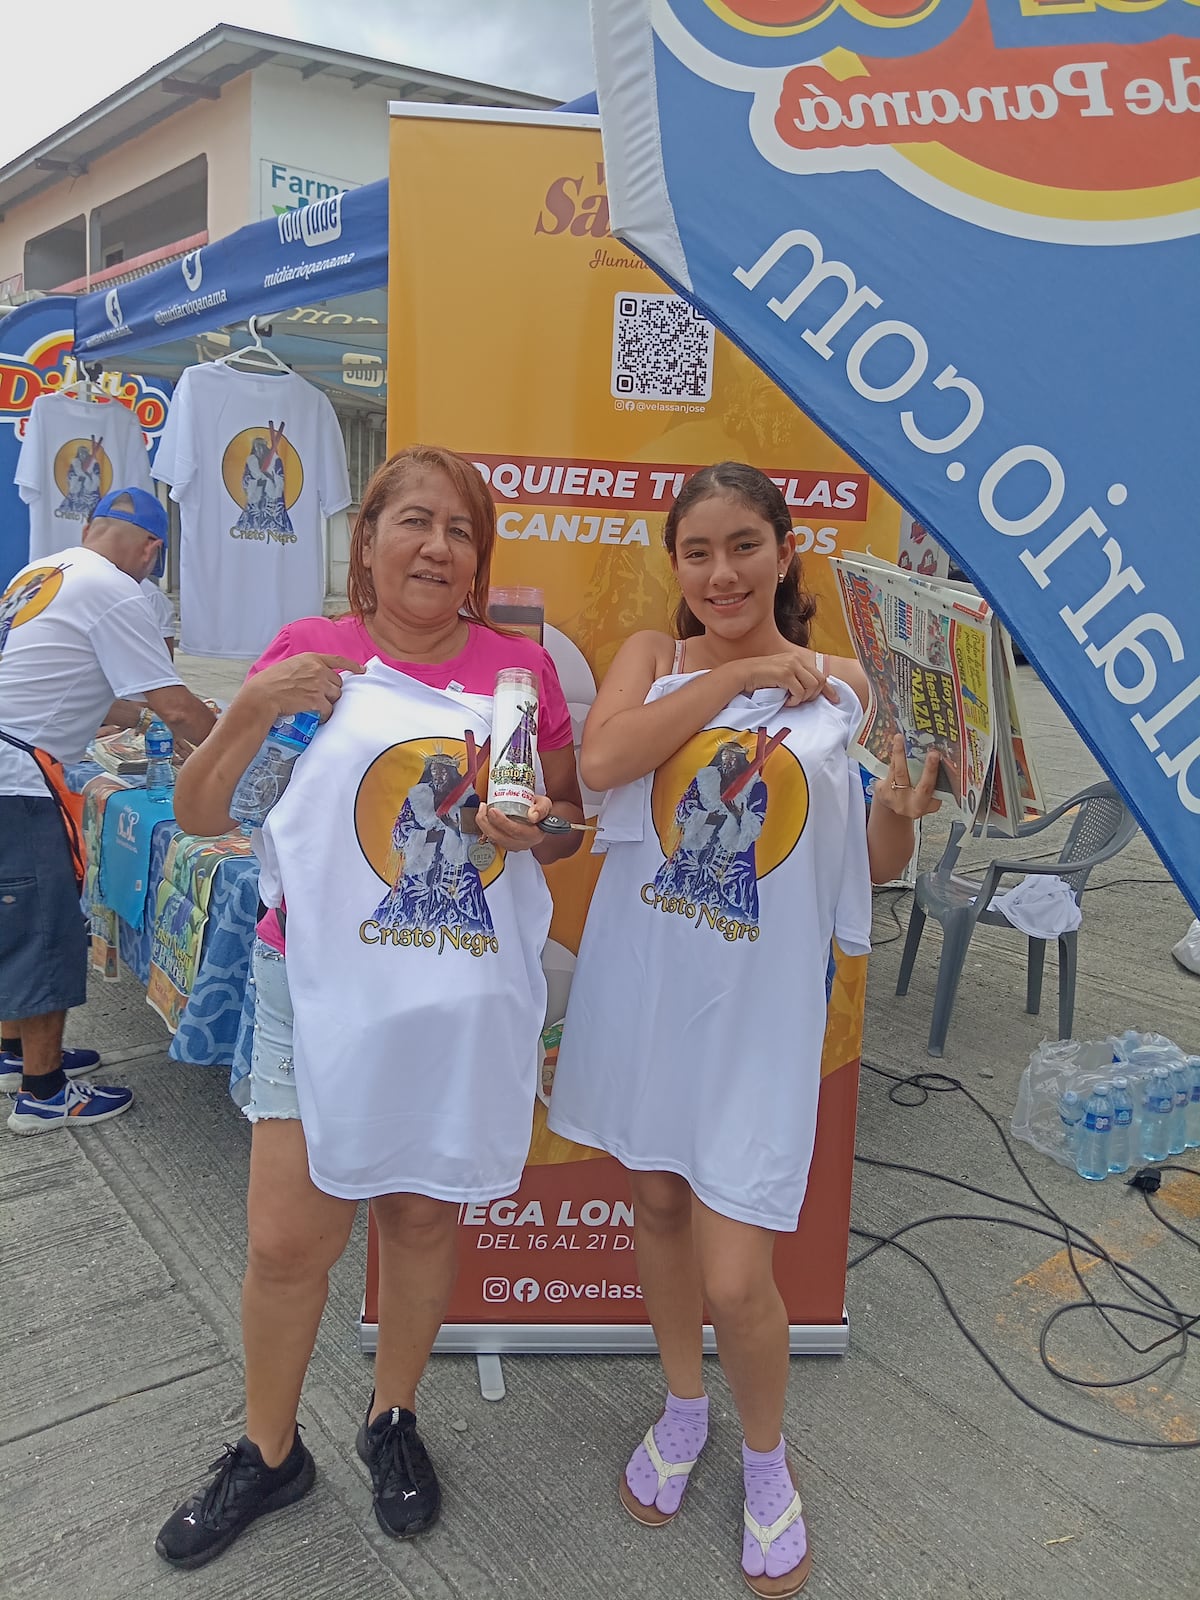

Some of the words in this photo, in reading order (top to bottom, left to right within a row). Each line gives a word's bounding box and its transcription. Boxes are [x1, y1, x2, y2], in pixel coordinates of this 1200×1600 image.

[271, 165, 348, 199] Farm
[534, 175, 616, 239] Sa
[636, 402, 706, 414] @velassanjose
[471, 462, 639, 499] DQUIERE
[650, 472, 695, 500] TU
[773, 478, 859, 509] LAS
[496, 511, 650, 546] CANJEA
[925, 671, 941, 711] fiesta
[934, 713, 948, 737] del
[941, 674, 953, 708] Hoy
[947, 707, 955, 726] es
[640, 883, 696, 919] Cristo
[695, 904, 760, 942] Negro
[359, 919, 436, 948] Cristo
[438, 924, 499, 957] Negro
[457, 1200, 545, 1228] EGA
[556, 1200, 635, 1228] LON
[476, 1233, 521, 1250] DEL
[527, 1234, 549, 1250] 16
[551, 1235, 581, 1250] AL
[585, 1234, 607, 1250] 21
[544, 1279, 644, 1303] @velass
